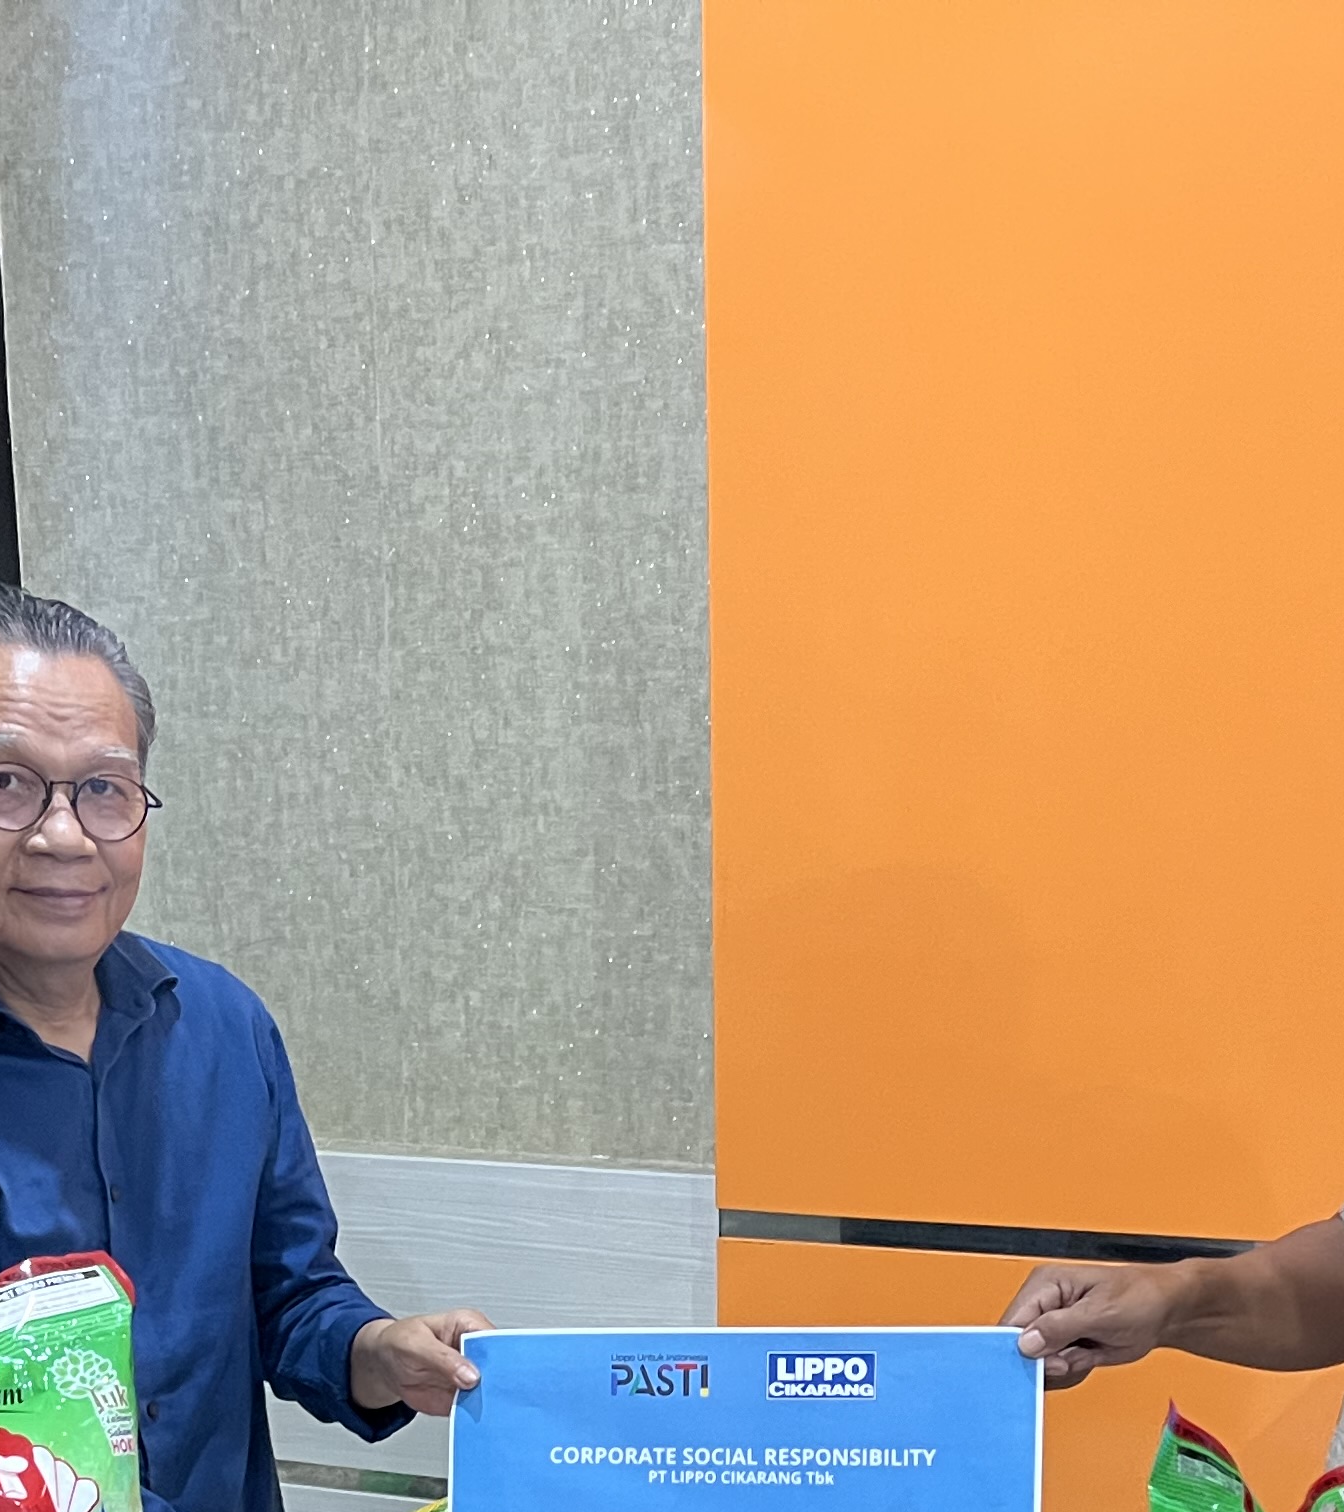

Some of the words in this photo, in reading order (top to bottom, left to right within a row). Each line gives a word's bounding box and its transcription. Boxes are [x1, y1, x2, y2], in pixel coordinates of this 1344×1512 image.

[777, 1357, 868, 1381] LIPPO
[768, 1381, 875, 1398] CIKARANG
[550, 1447, 677, 1465] CORPORATE
[682, 1447, 758, 1466] SOCIAL
[764, 1448, 937, 1467] RESPONSIBILITY
[648, 1470, 667, 1484] PT
[671, 1470, 717, 1484] LIPPO
[721, 1470, 802, 1486] CIKARANG
[805, 1471, 835, 1486] Tbk
